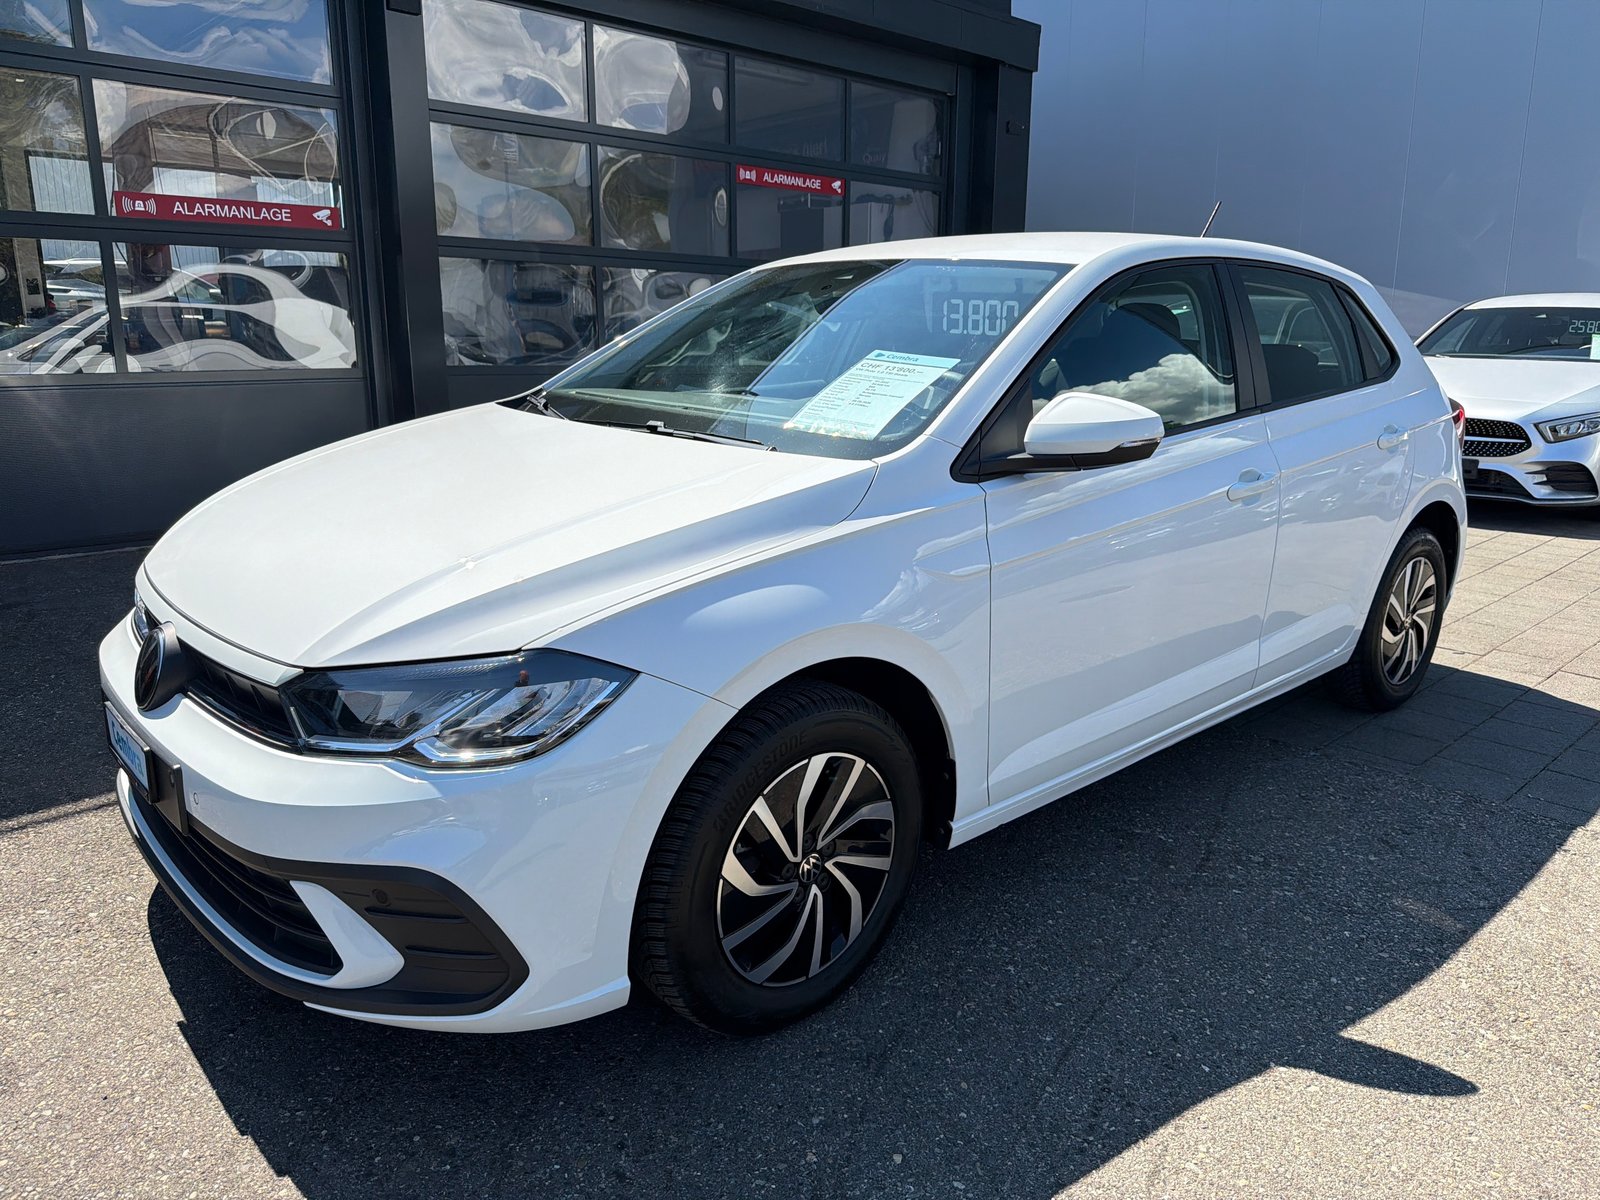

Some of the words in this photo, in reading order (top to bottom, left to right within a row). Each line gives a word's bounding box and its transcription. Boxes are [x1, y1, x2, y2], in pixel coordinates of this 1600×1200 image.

[763, 172, 822, 190] ALARMANLAGE
[173, 201, 292, 222] ALARMANLAGE
[886, 353, 919, 362] Cembra
[713, 731, 809, 832] BRIDGESTONE
